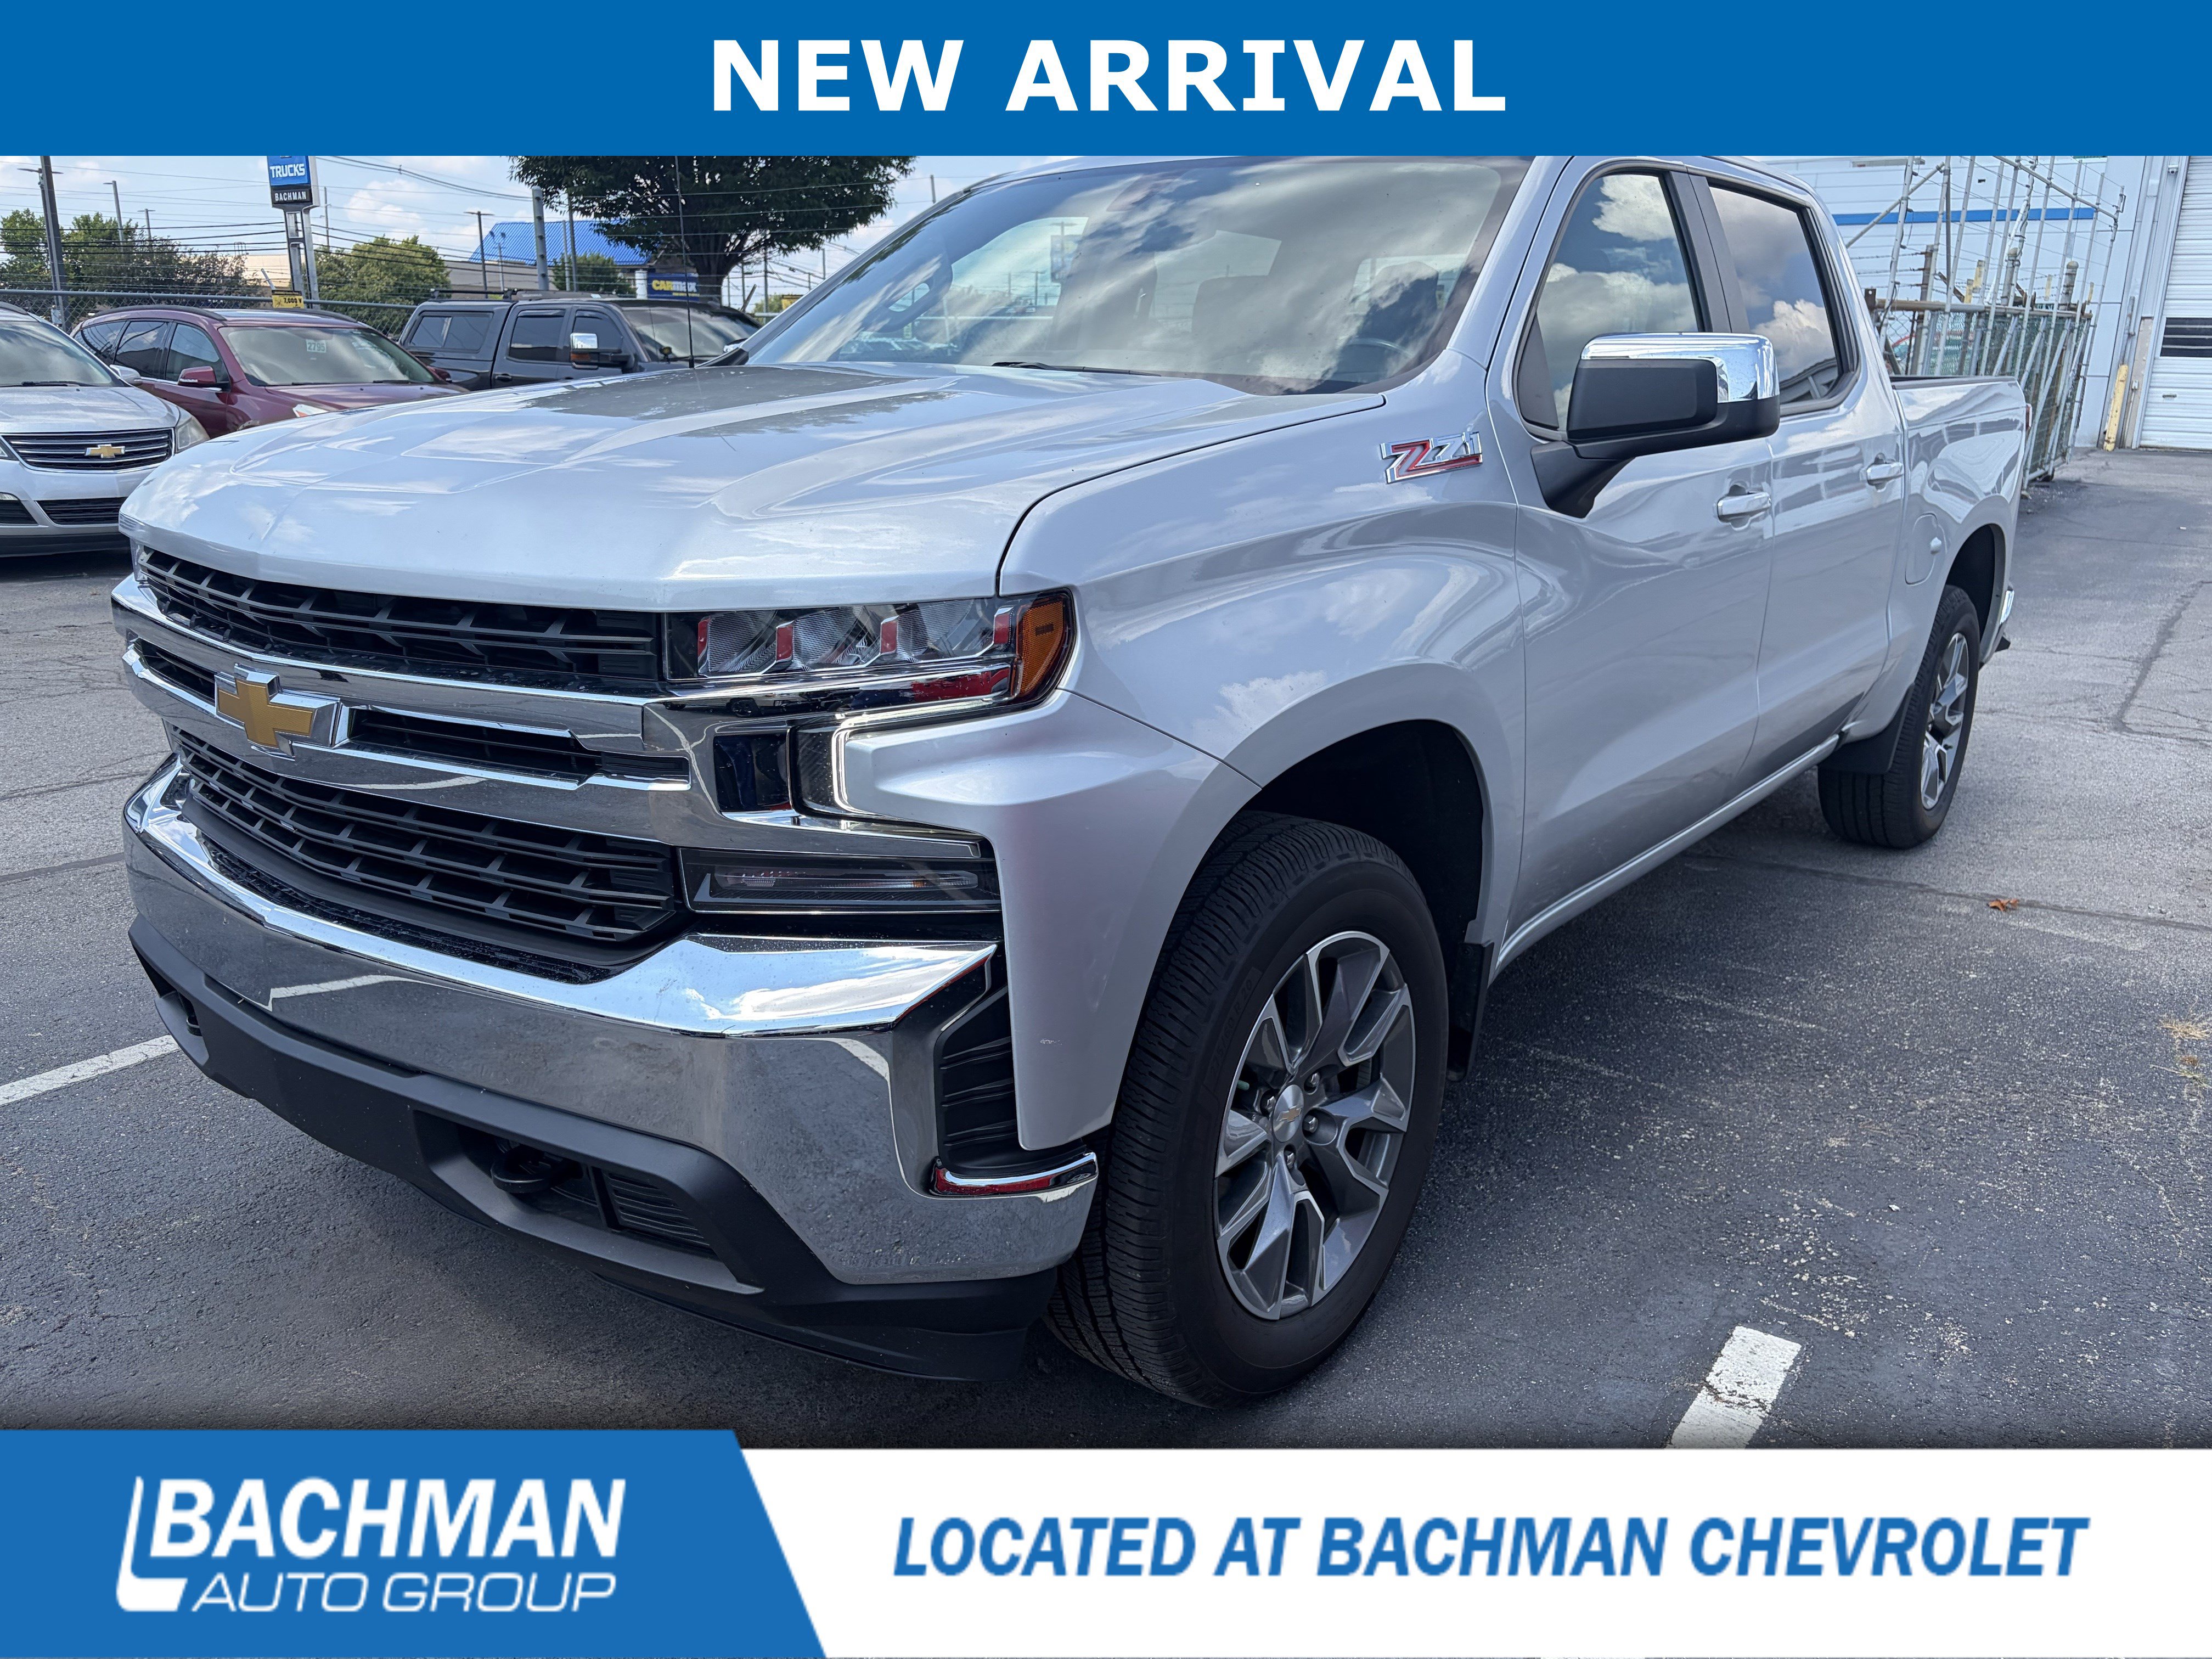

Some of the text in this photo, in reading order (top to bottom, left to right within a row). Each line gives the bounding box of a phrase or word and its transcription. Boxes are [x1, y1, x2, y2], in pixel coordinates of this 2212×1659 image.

[269, 164, 306, 178] TRUCKS
[274, 191, 307, 201] BACHMAN
[307, 342, 325, 352] 2795
[1380, 432, 1483, 484] Z71
